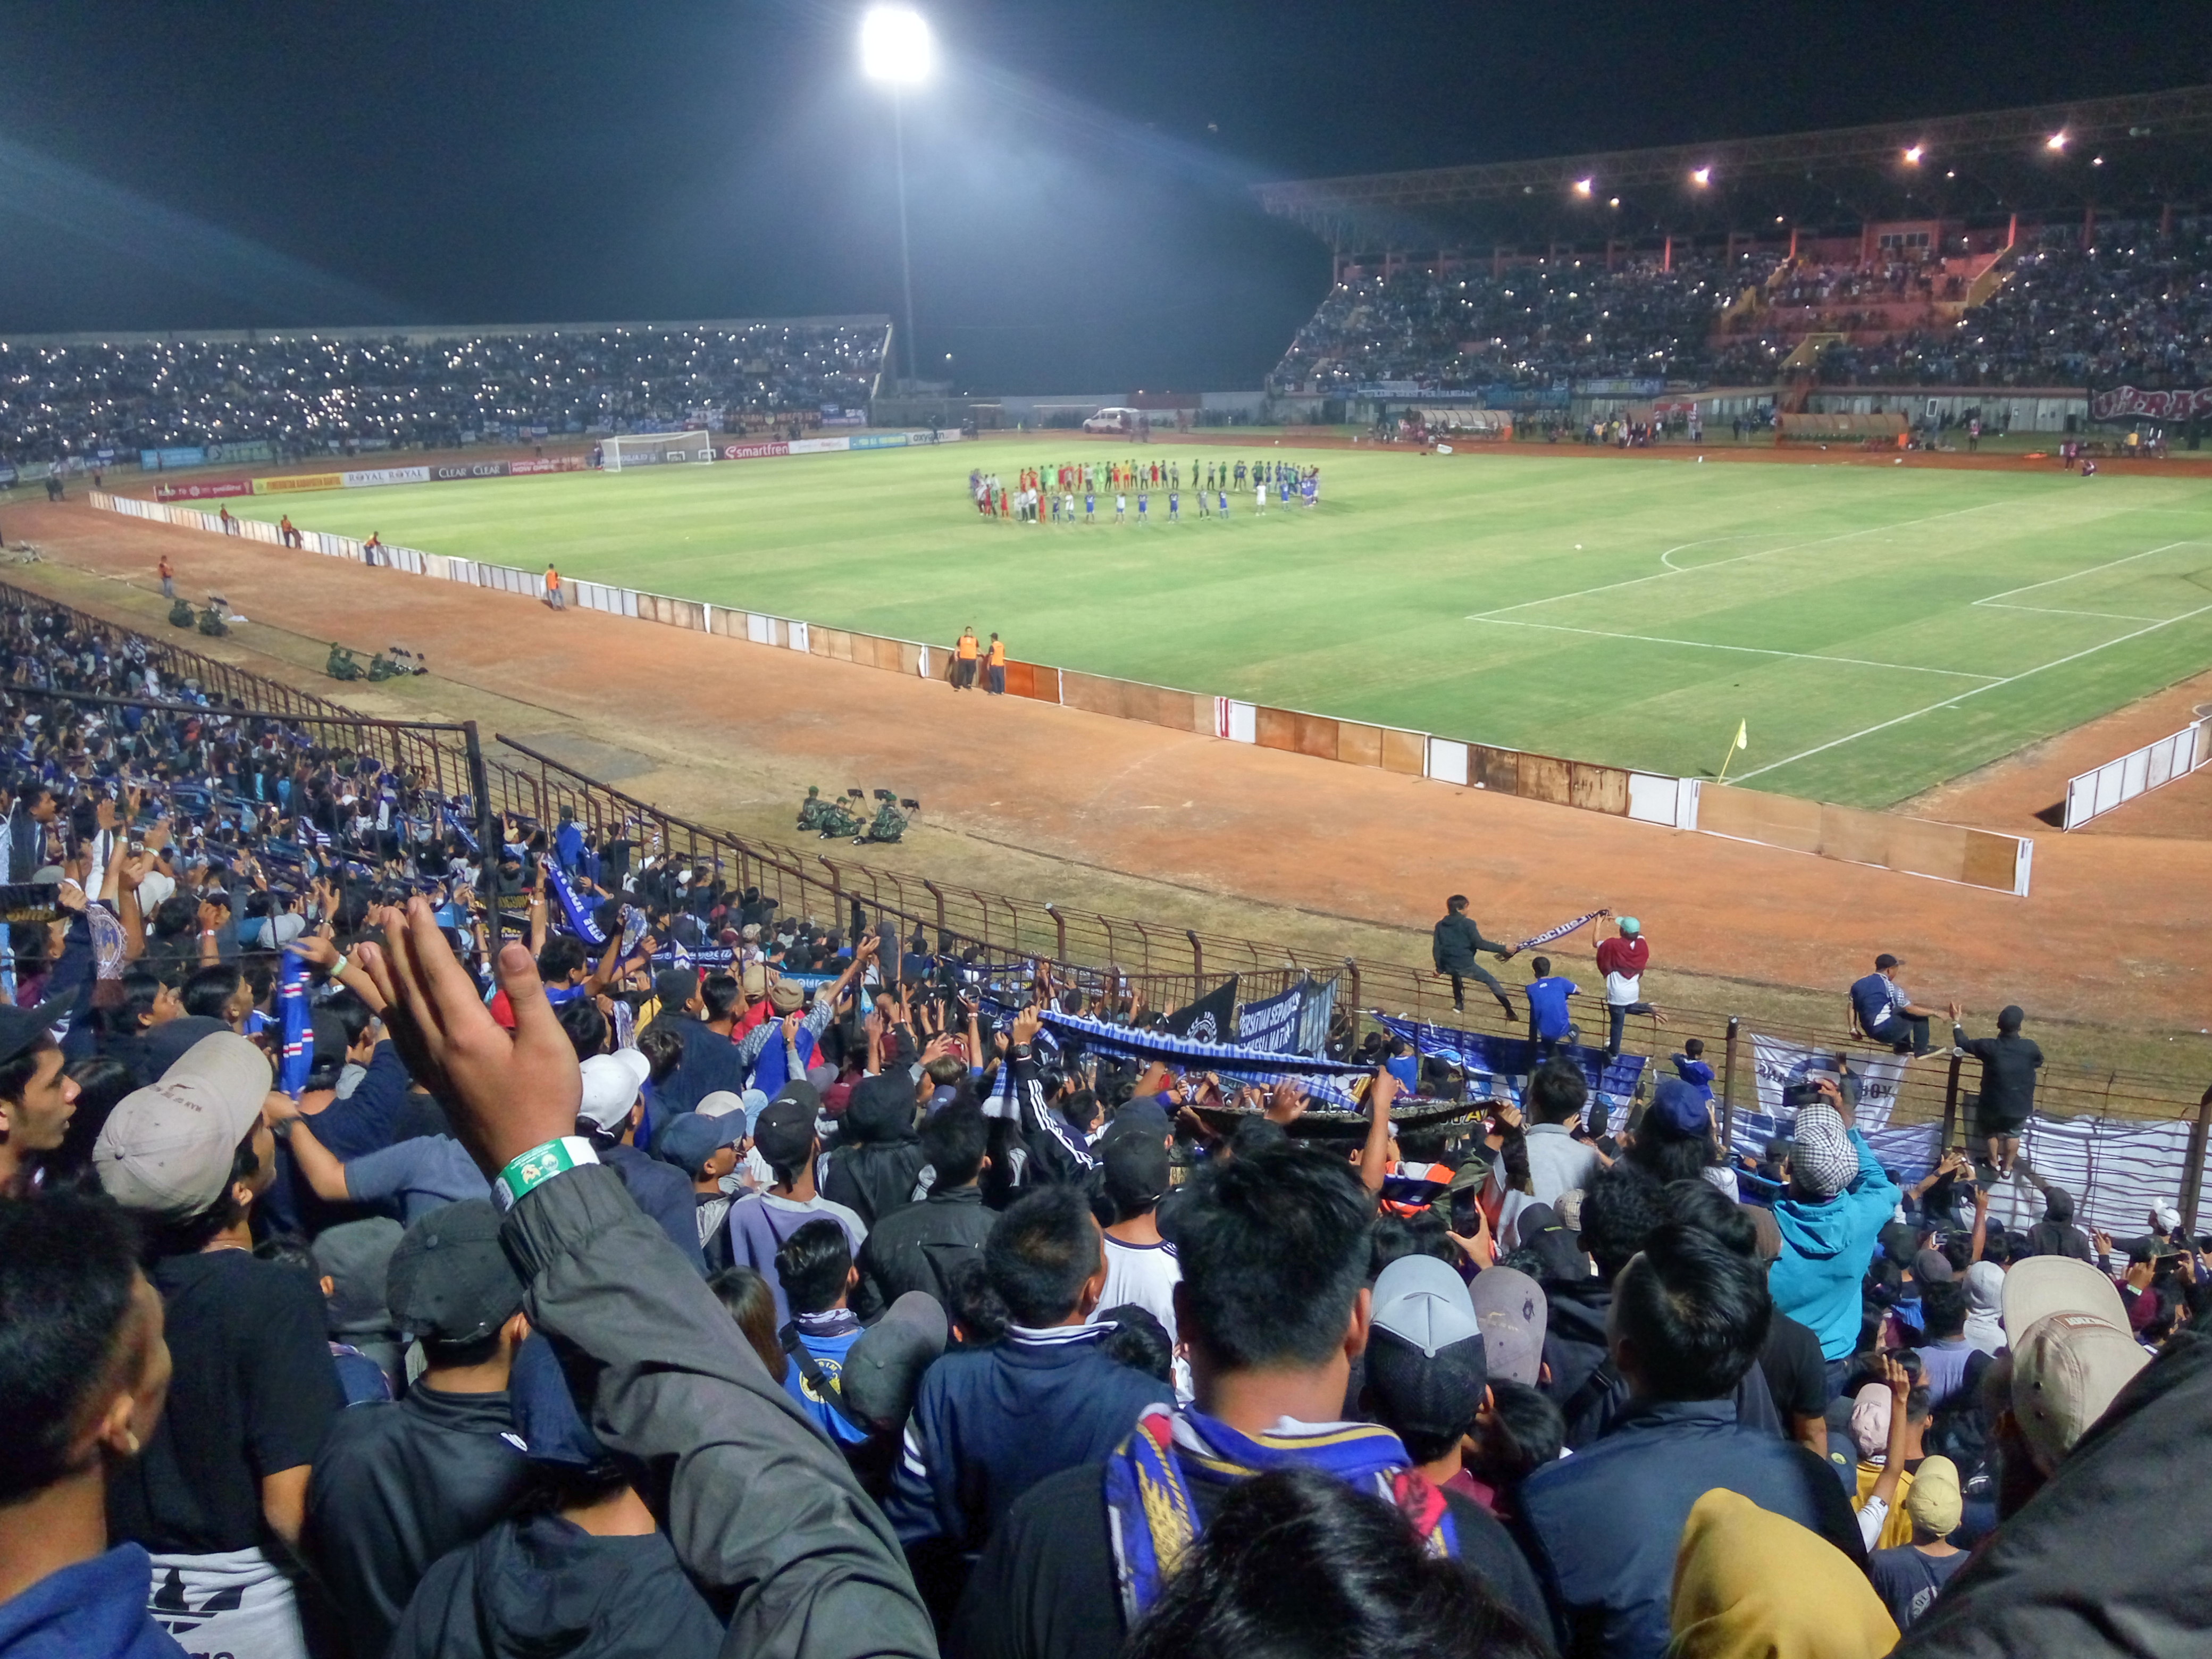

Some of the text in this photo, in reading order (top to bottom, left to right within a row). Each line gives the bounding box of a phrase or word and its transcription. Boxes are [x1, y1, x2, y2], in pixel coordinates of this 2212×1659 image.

[736, 443, 789, 458] smartfren
[349, 468, 422, 482] ROYAL ROYAL
[439, 465, 500, 479] CLEAR CLEAR
